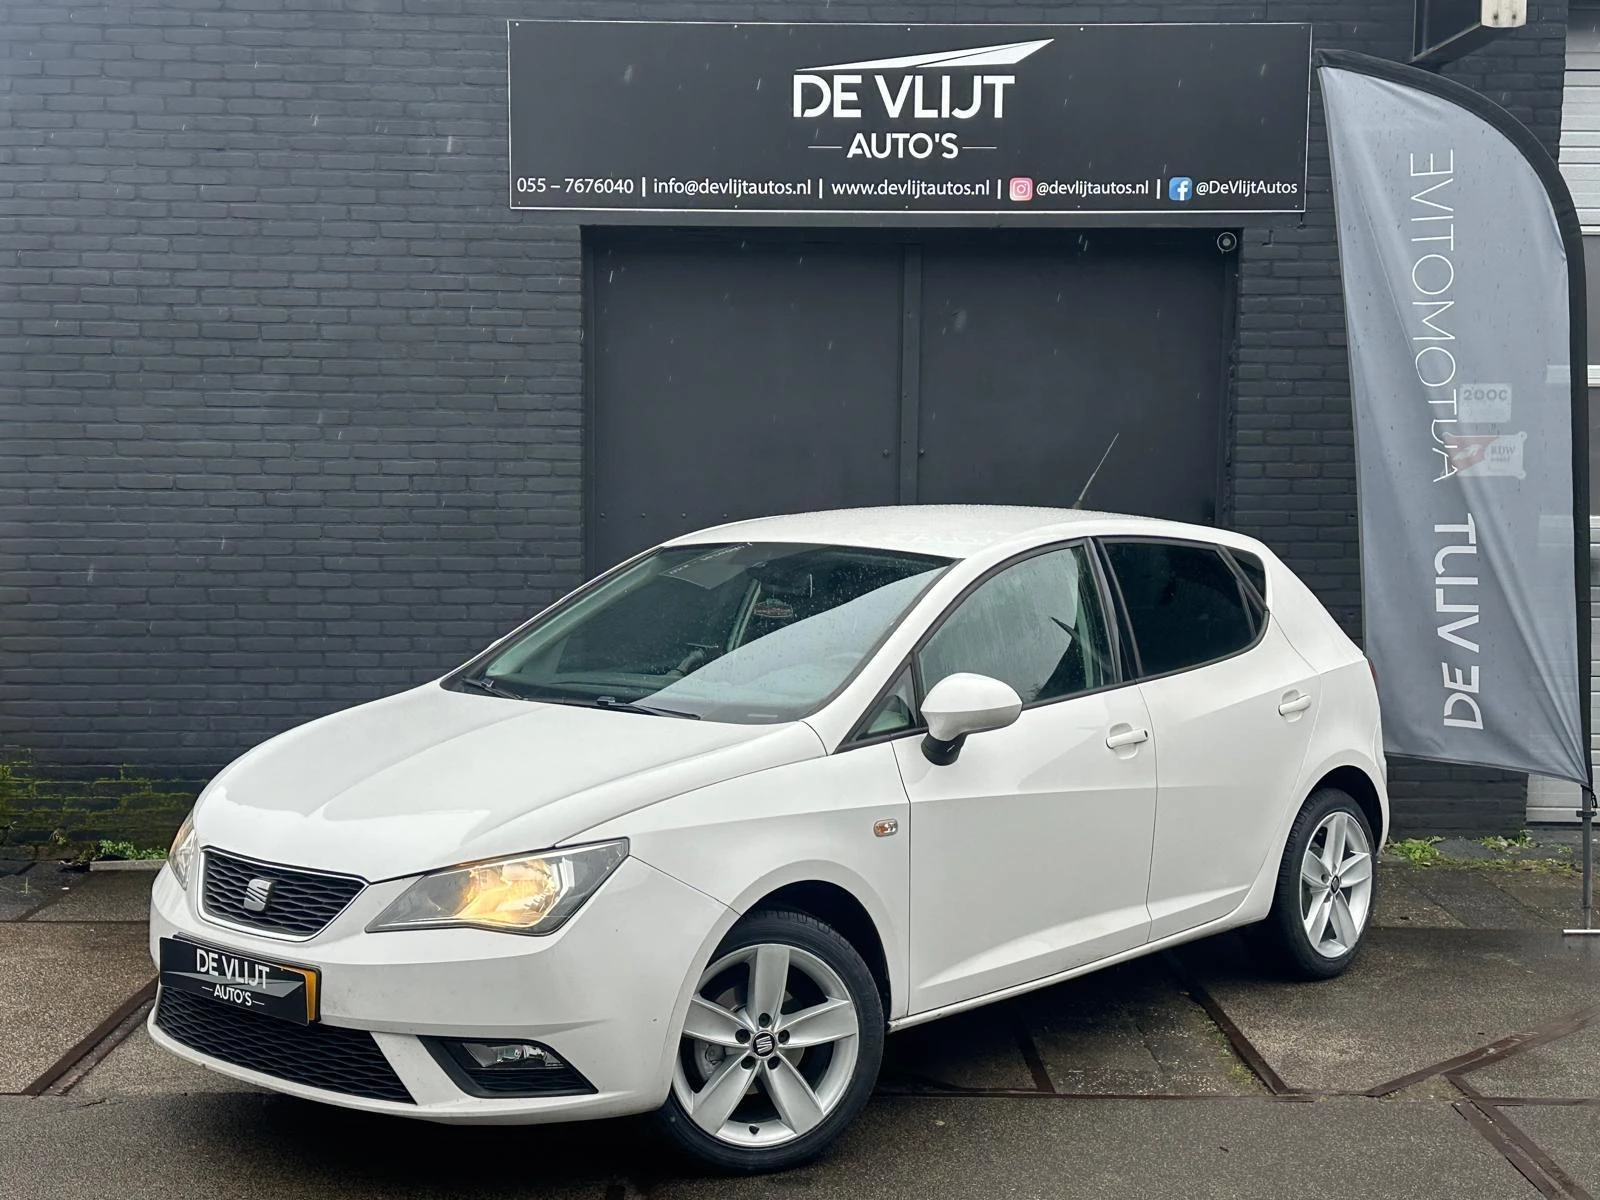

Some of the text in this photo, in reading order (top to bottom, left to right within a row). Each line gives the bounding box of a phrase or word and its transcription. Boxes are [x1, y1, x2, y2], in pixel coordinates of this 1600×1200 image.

[793, 74, 1015, 119] DE VLIJT
[846, 132, 959, 159] AUTO'S
[516, 177, 546, 193] 055
[564, 178, 634, 194] 7676040
[653, 178, 811, 197] info@devlijtautos.nl
[831, 180, 990, 198] www.devlijtautos.nl
[1036, 180, 1149, 198] @devlijtautos.nl
[1196, 180, 1298, 198] @DeVlijtAutos
[196, 948, 270, 990] DE VLIJT
[213, 983, 252, 1007] AUTO'S
